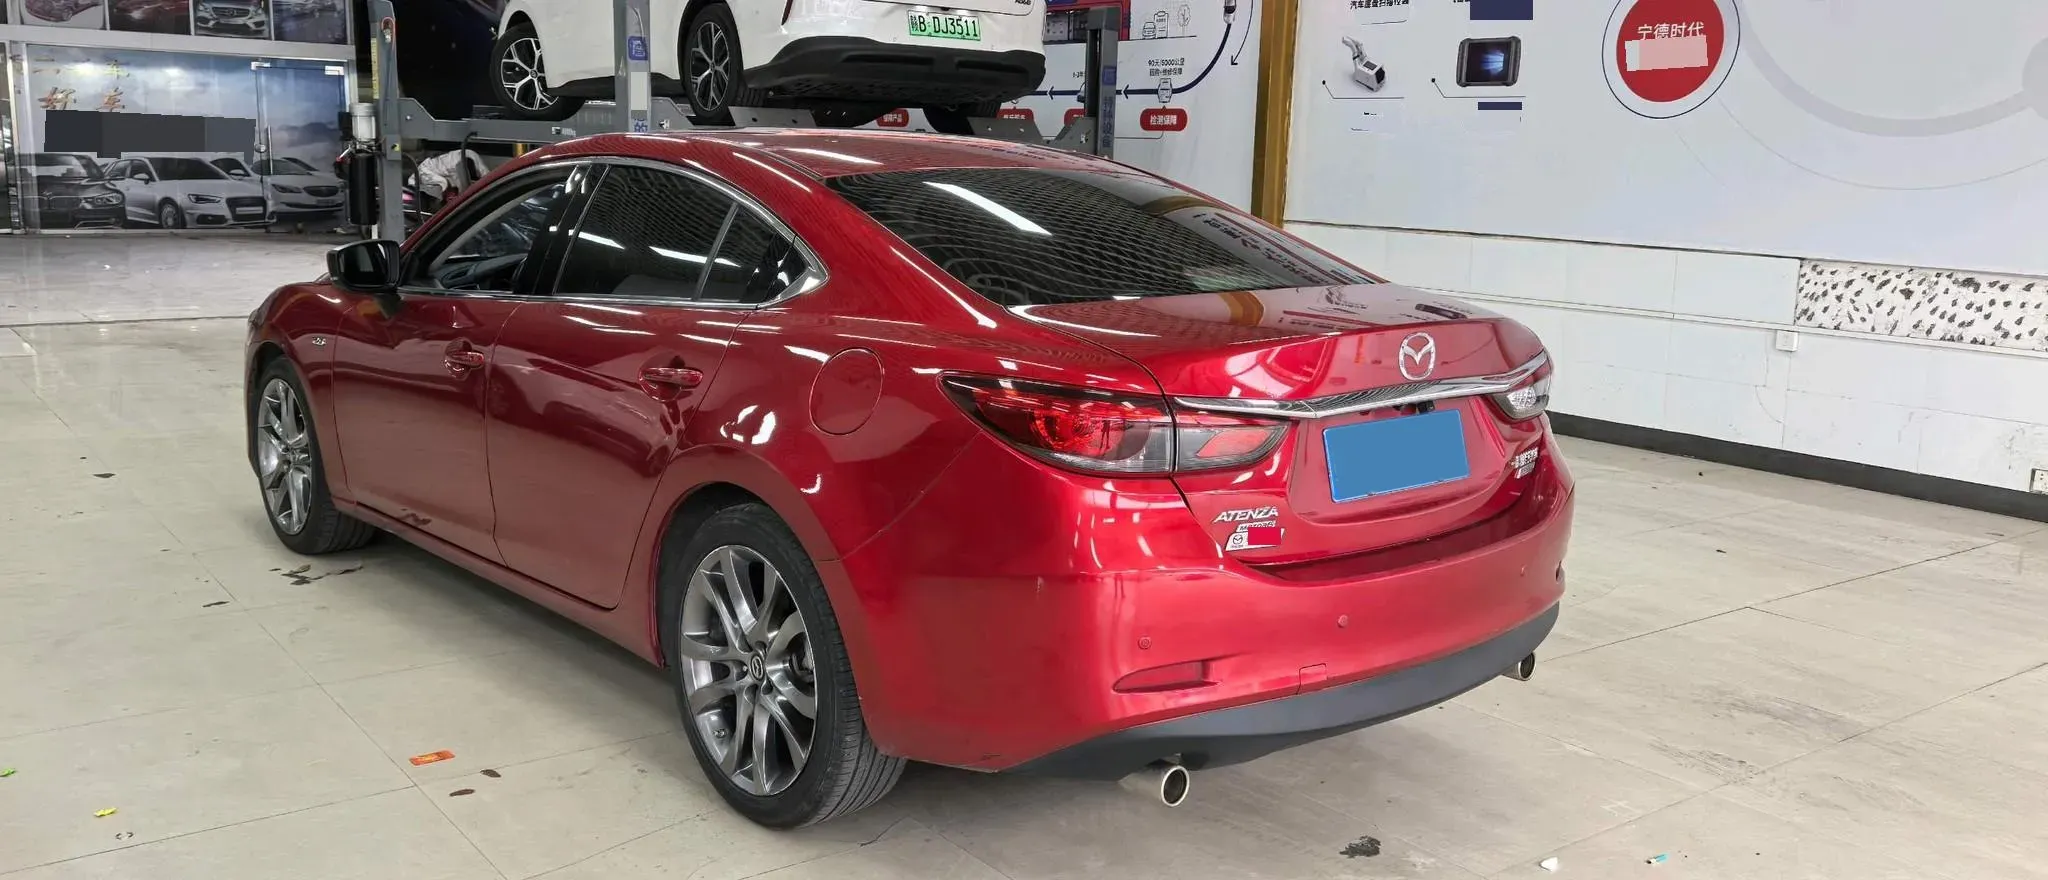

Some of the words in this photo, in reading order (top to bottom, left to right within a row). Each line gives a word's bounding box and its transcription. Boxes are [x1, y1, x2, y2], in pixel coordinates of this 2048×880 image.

[1638, 22, 1705, 40] 宁德时代
[1212, 507, 1279, 523] ATENZA
